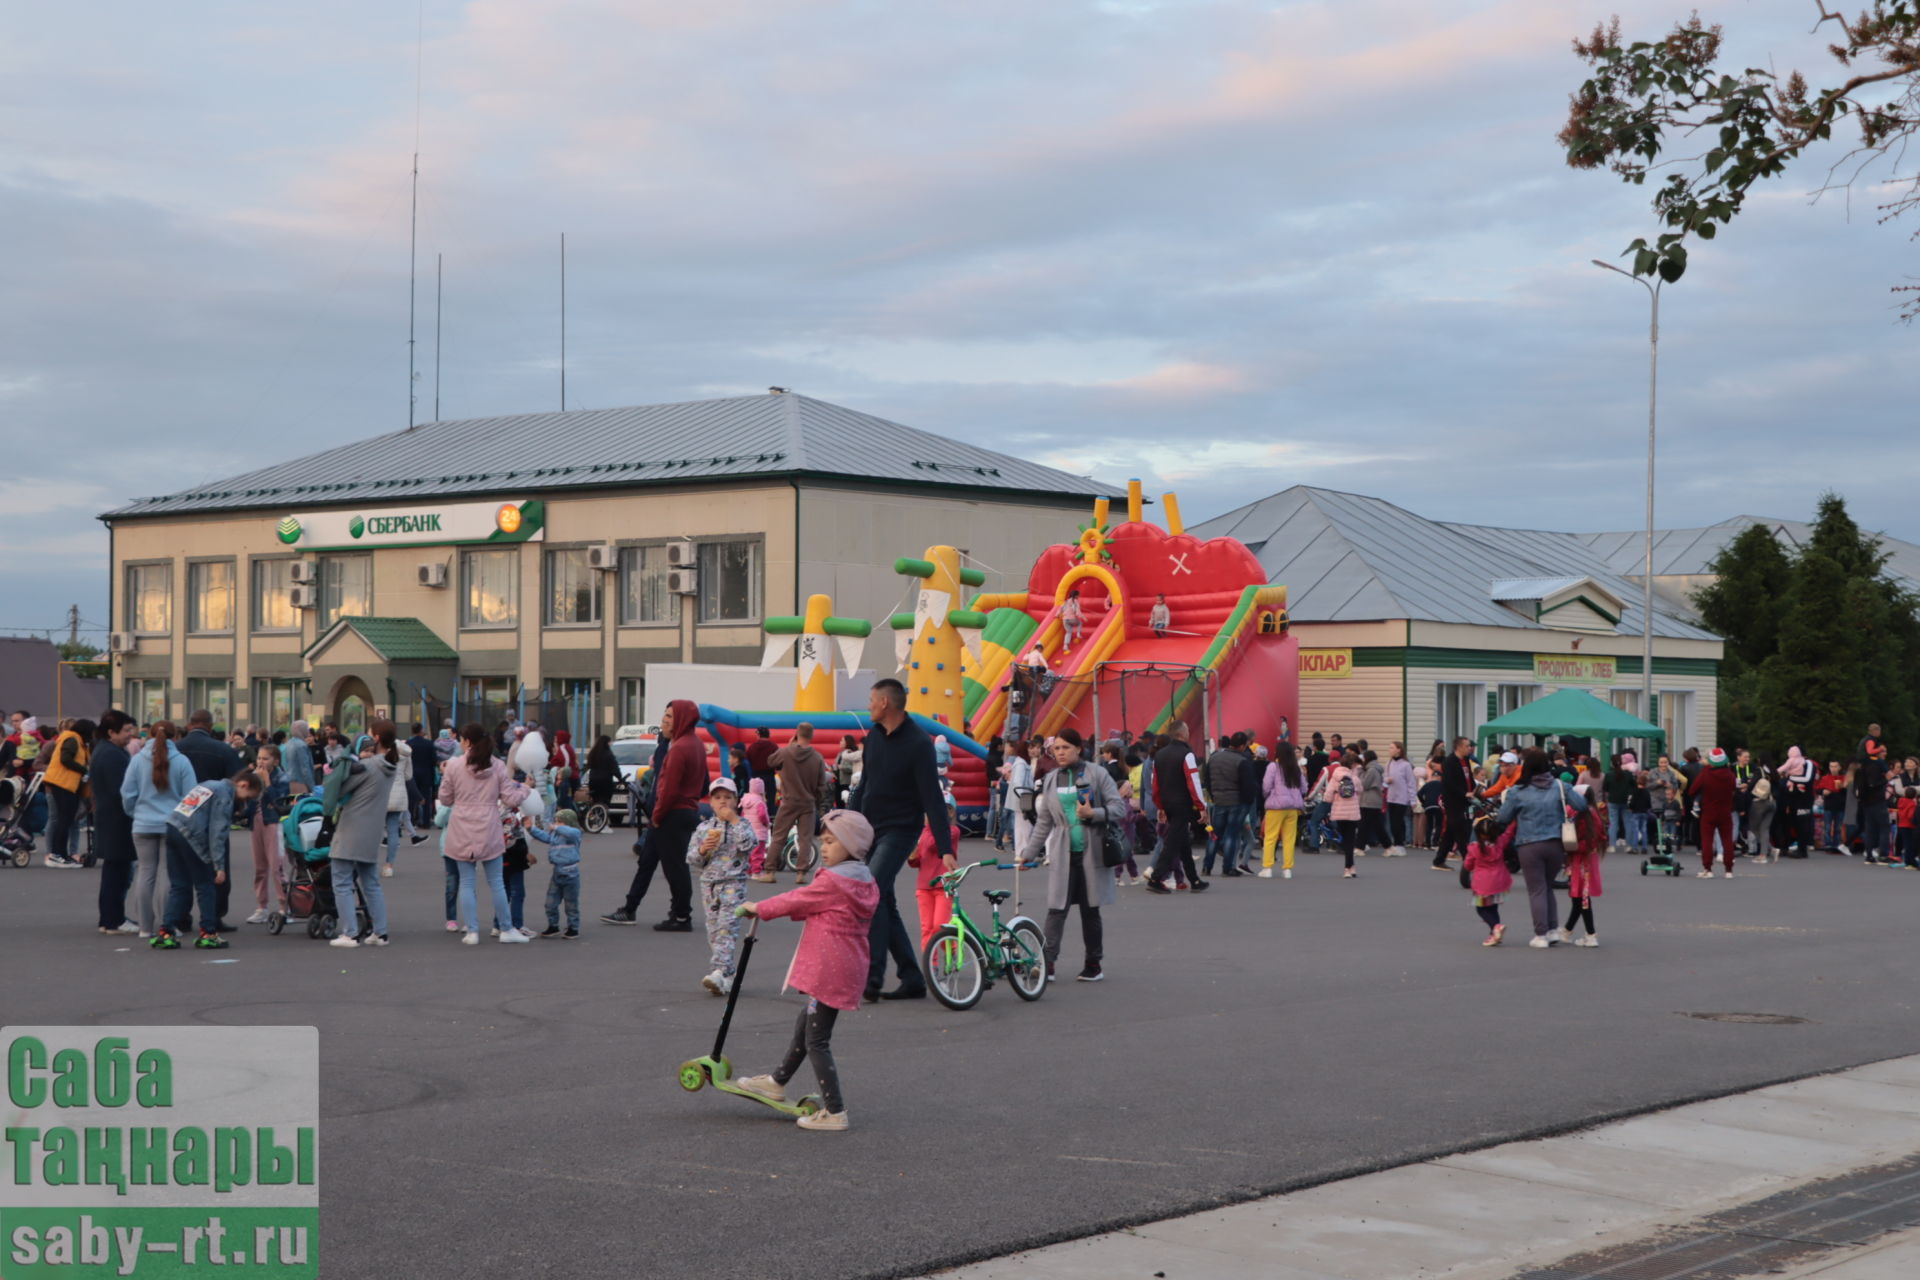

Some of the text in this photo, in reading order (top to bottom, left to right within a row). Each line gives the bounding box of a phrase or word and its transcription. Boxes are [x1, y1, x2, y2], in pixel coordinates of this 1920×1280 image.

[368, 513, 442, 534] СБЕРБАНК
[502, 510, 517, 522] 24
[1537, 660, 1613, 678] ПРОДУКТЫ ХЛЕБ
